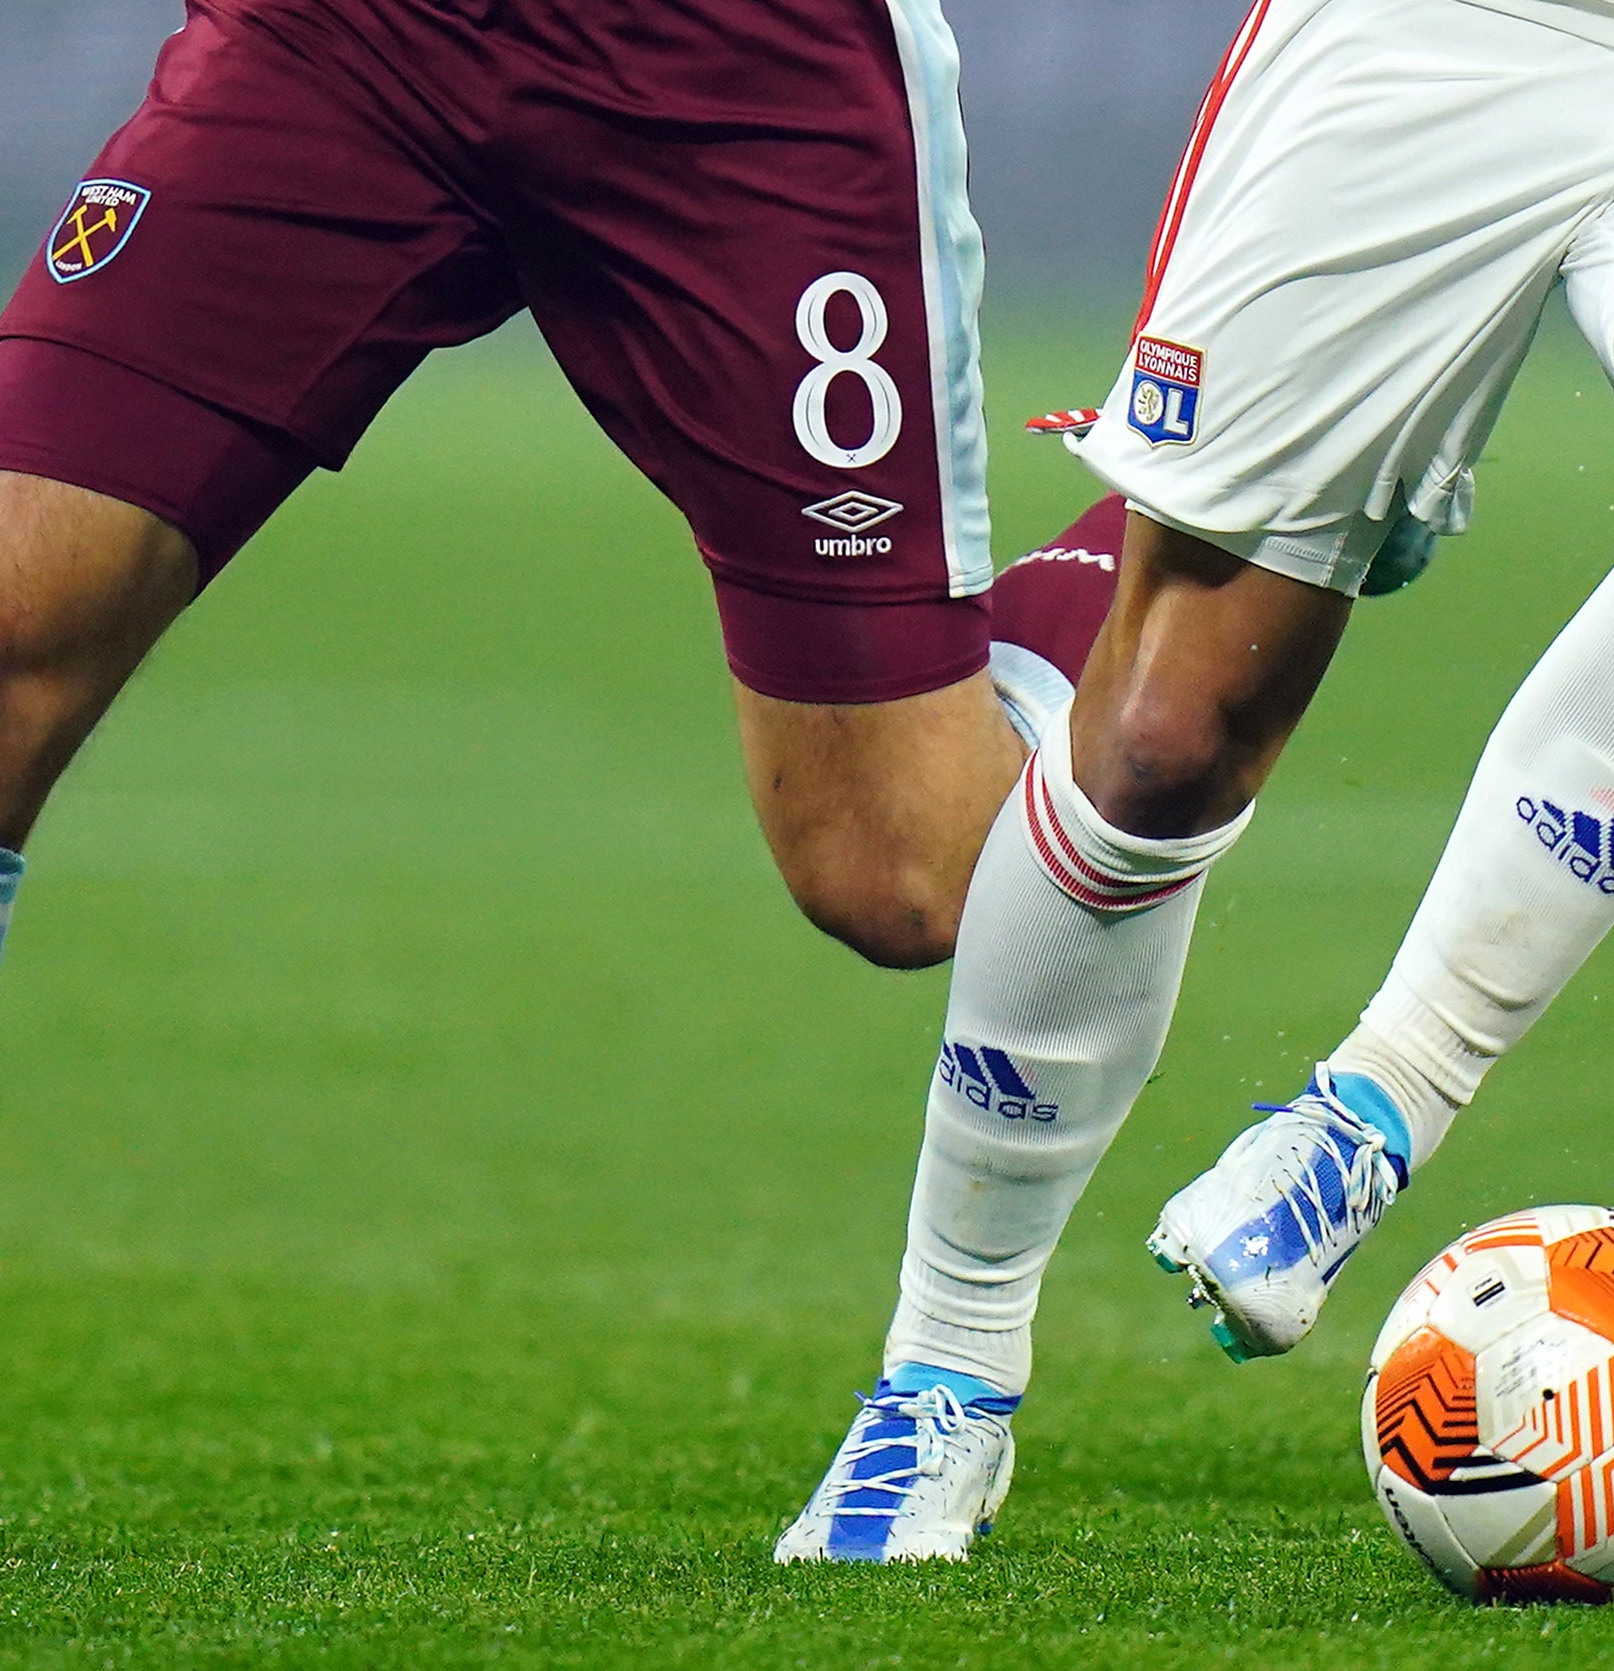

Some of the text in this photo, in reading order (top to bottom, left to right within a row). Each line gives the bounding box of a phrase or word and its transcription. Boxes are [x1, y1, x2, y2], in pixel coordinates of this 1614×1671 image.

[106, 187, 137, 205] HAM
[1138, 352, 1197, 383] LYONNAIS
[1140, 340, 1198, 368] OLYMPIQUE
[793, 271, 903, 469] 8
[815, 534, 892, 557] umbro
